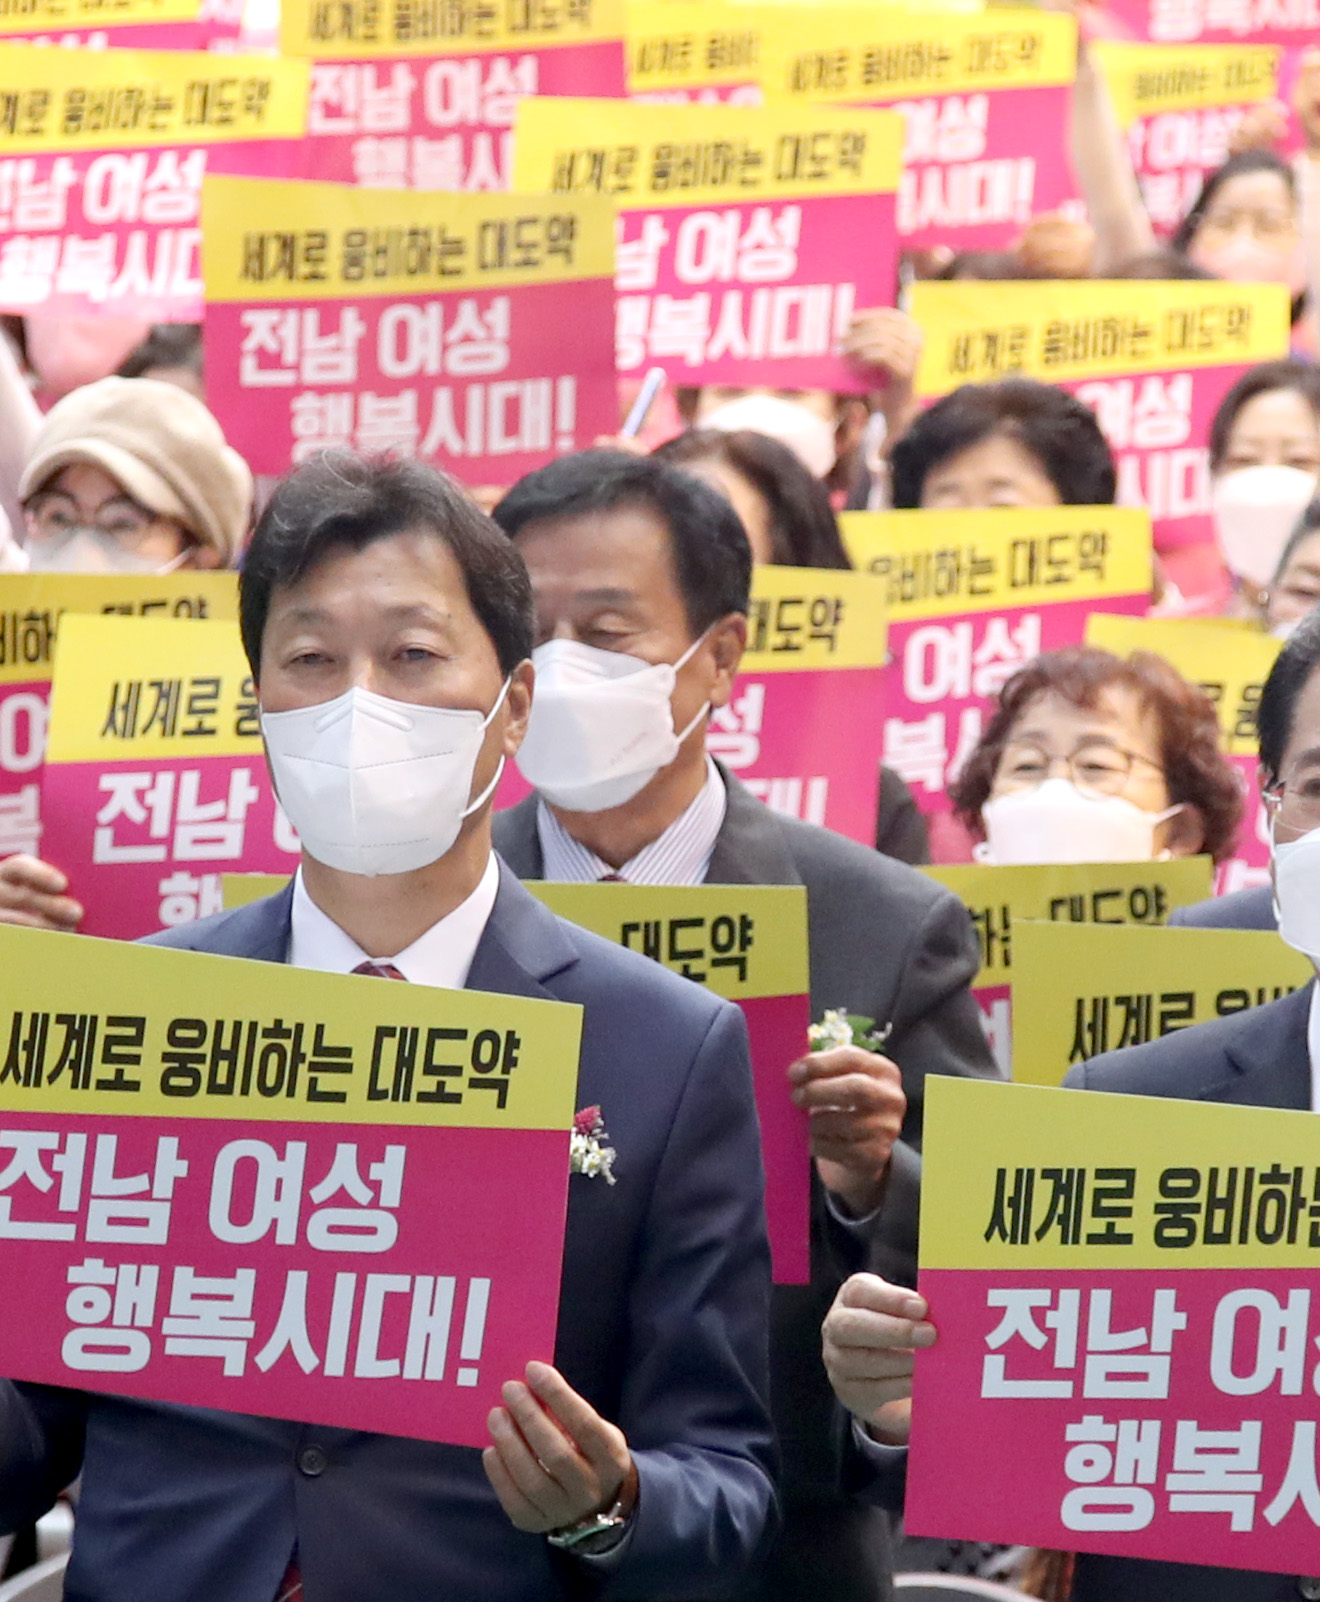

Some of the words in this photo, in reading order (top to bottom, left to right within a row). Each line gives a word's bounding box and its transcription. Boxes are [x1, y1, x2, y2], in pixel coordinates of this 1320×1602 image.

[308, 61, 418, 136] 전남
[0, 154, 77, 233] 남
[82, 148, 208, 225] 여성
[240, 230, 329, 284] 세계로
[340, 223, 466, 283] 웅비하는
[477, 211, 580, 271] 대도약
[674, 204, 801, 284] 여성
[239, 305, 366, 388] 전남
[376, 295, 512, 378] 여성
[1009, 528, 1112, 589] 대도약
[101, 676, 223, 740] 세계로
[93, 766, 260, 865] 전남
[0, 1010, 147, 1093] 세계로
[159, 1017, 354, 1104] 웅비하는
[366, 1025, 521, 1110] 대도약
[0, 1129, 189, 1246] 전남
[207, 1137, 407, 1254] 여성
[984, 1167, 1137, 1246] 세계로
[60, 1257, 492, 1388] 행복시대!
[980, 1287, 1189, 1401] 전남
